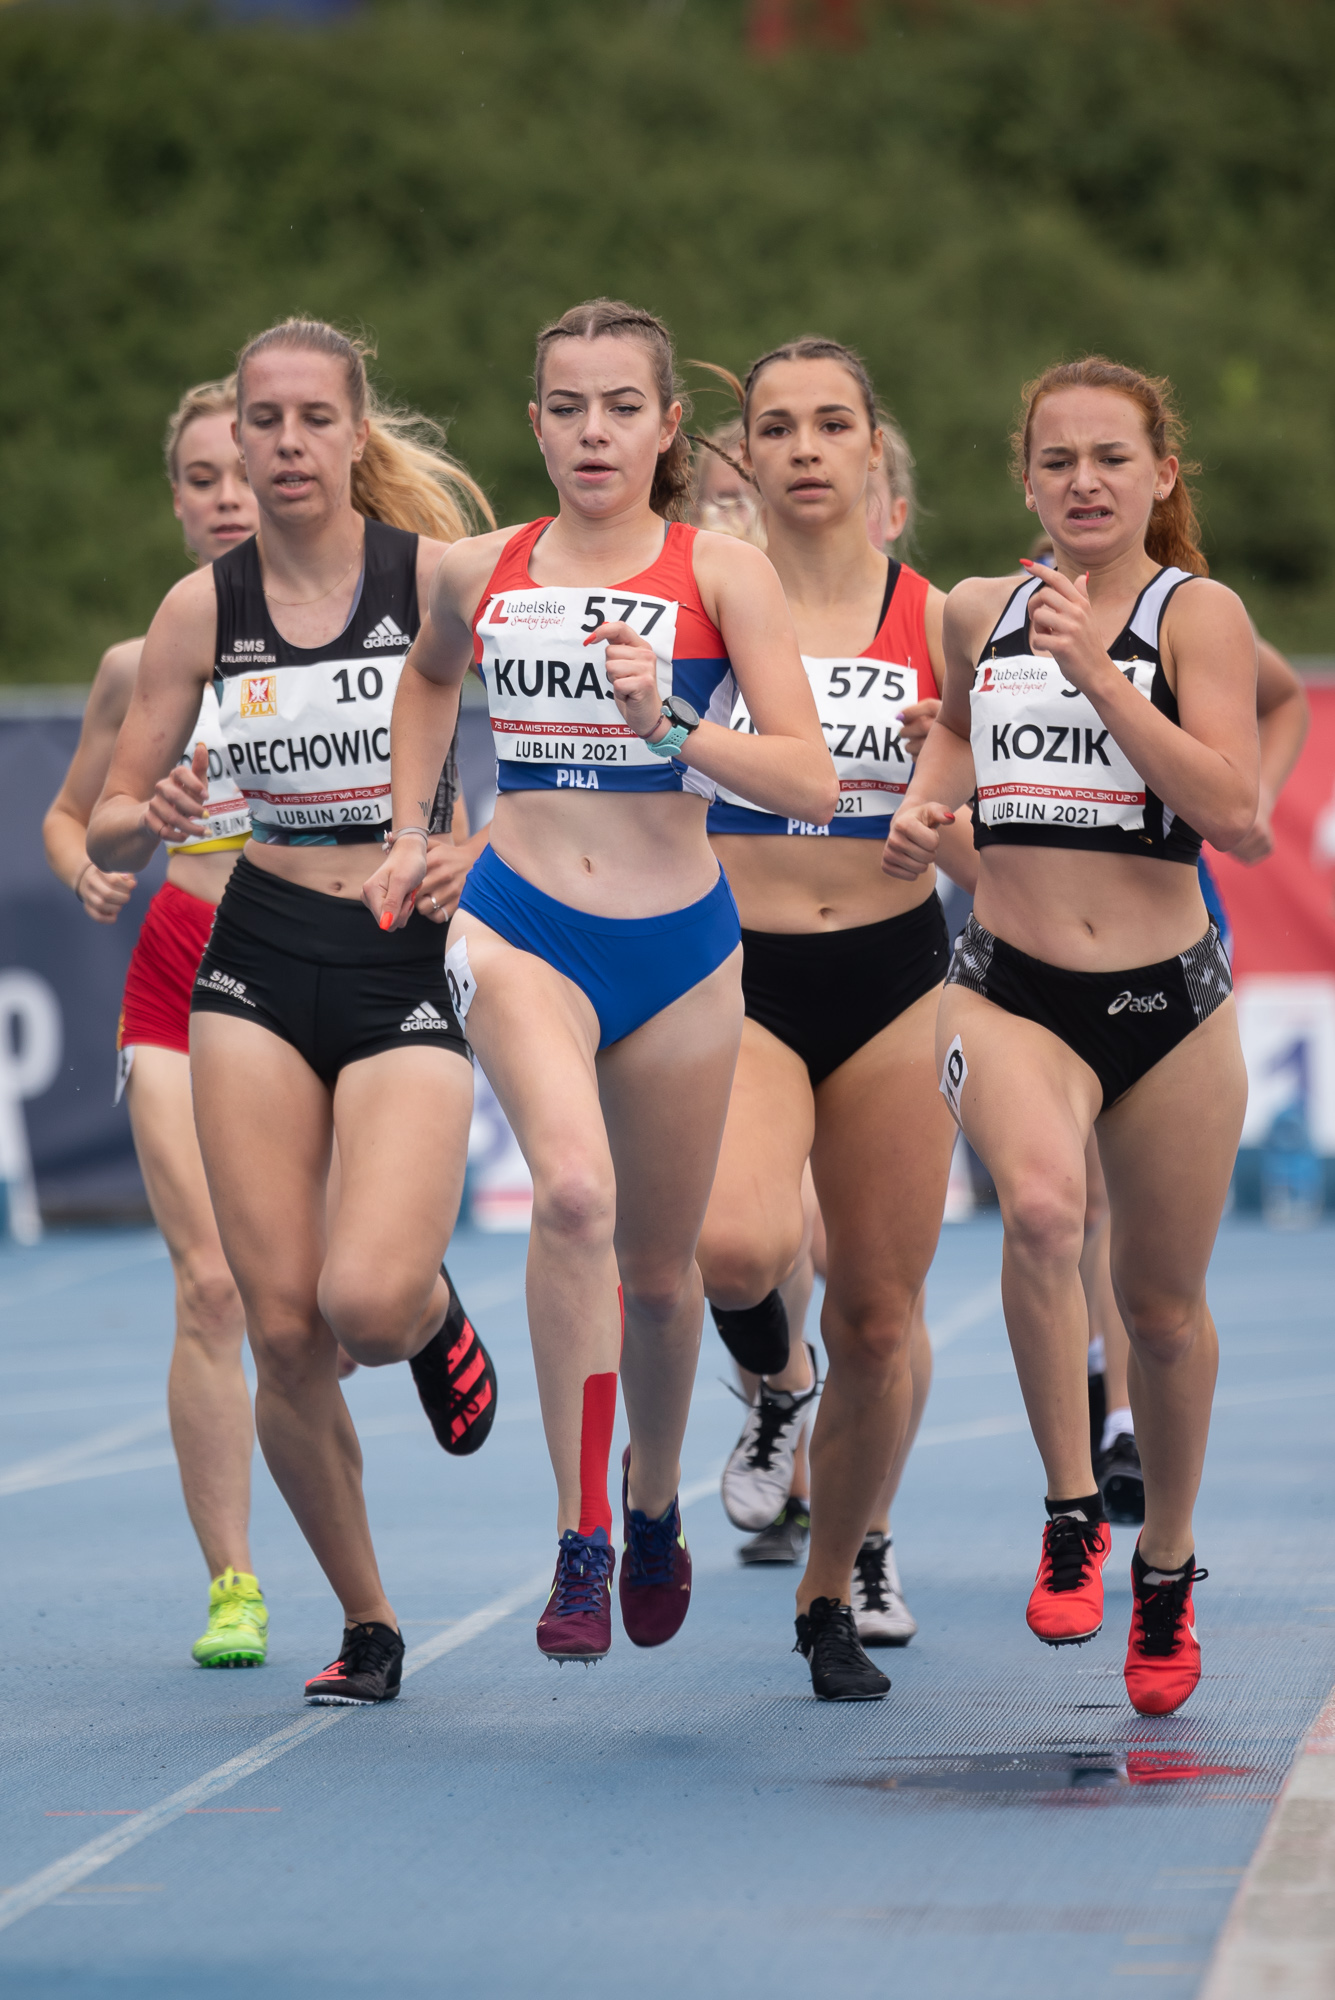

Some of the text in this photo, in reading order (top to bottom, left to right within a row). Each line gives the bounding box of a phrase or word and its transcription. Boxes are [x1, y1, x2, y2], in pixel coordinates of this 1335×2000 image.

[507, 601, 566, 614] lubelskie
[233, 640, 266, 653] SMS
[363, 633, 411, 649] adidas
[332, 666, 384, 705] 10
[827, 666, 905, 702] 575
[242, 703, 276, 717] PZLA
[503, 723, 524, 732] PZLA
[524, 724, 600, 735] MISTRZOSTWA
[515, 741, 627, 761] LUBLIN 2021
[992, 723, 1111, 767] KOZIK
[556, 769, 599, 790] PIŁA
[841, 781, 900, 793] POLSKI U20
[282, 791, 354, 804] MISTRZOSTWA
[355, 785, 390, 798] POLSKI
[1001, 784, 1073, 798] MISTRZOSTWA
[1075, 790, 1114, 801] POLSKI
[1115, 792, 1138, 803] U20
[276, 804, 382, 826] LUBLIN 2021
[992, 801, 1099, 826] LUBLIN 2021
[209, 969, 247, 995] SMS
[400, 1017, 448, 1032] adidas
